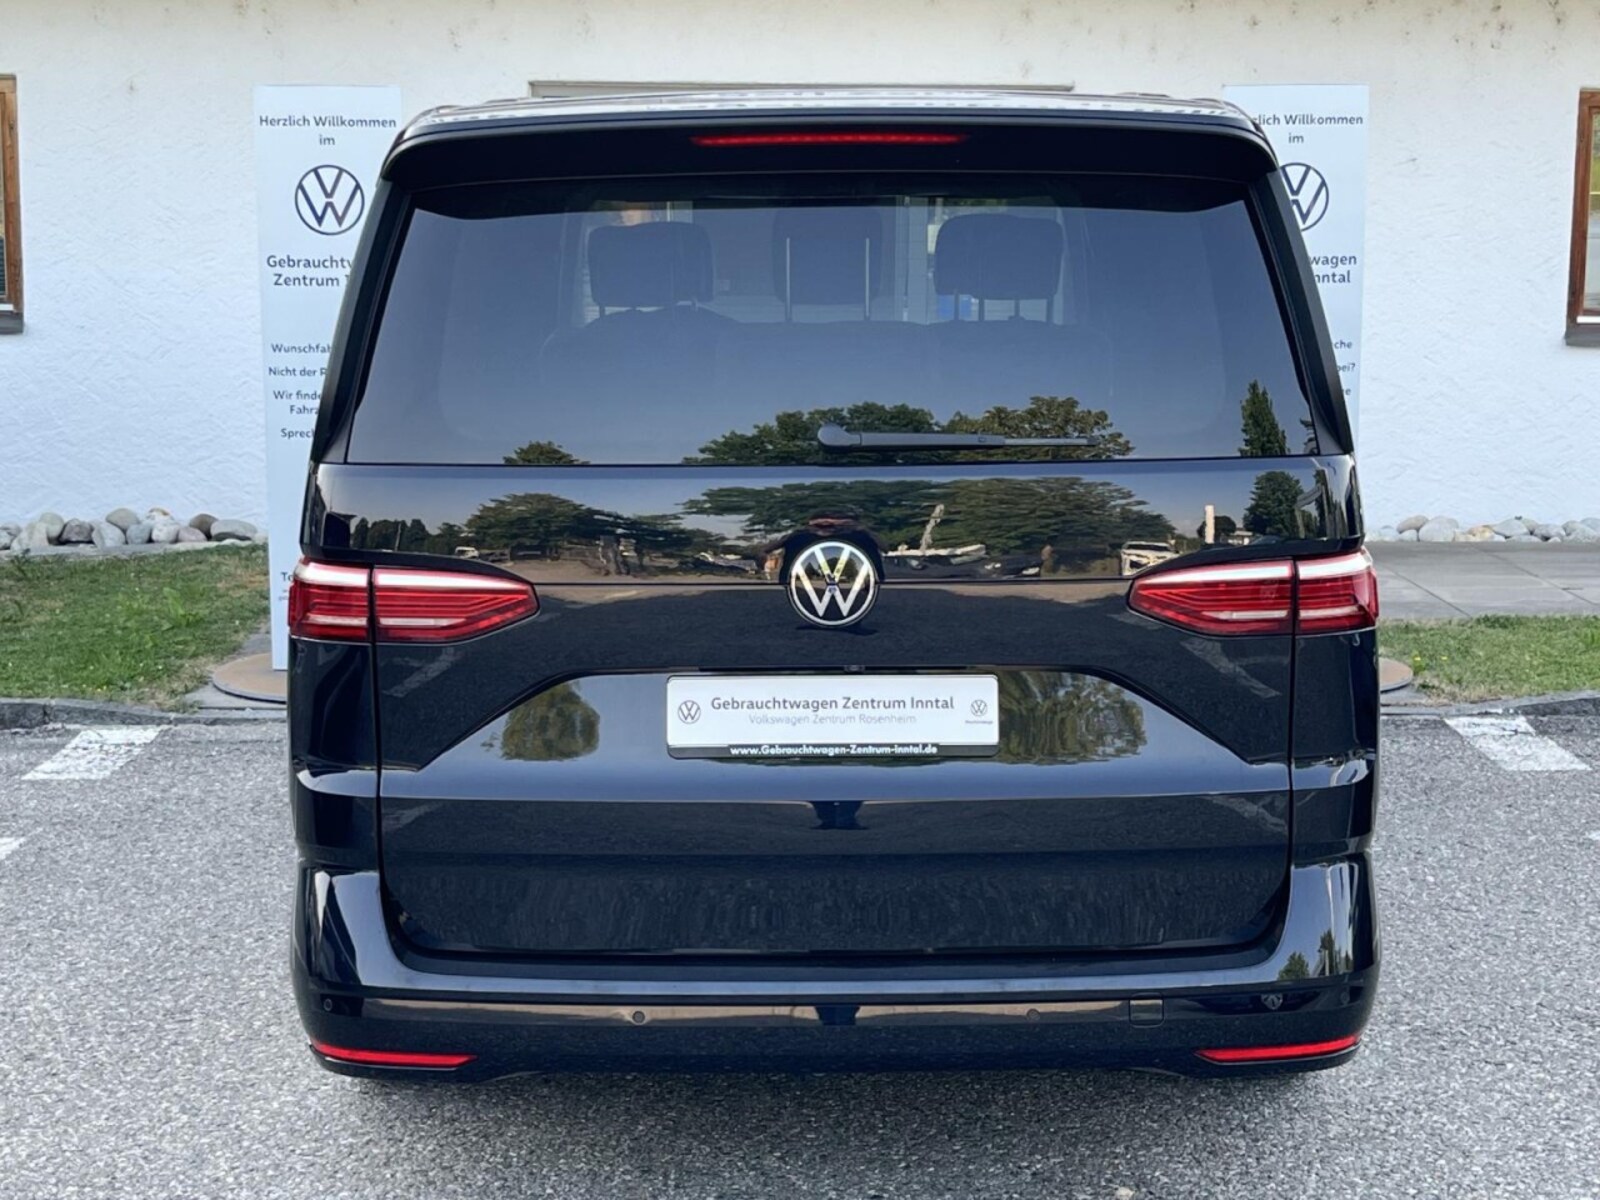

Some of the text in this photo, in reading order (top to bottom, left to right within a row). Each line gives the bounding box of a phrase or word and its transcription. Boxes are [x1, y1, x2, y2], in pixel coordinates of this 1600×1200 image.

[259, 115, 397, 128] Herzlich Willkommen
[1284, 114, 1364, 125] Willkommen
[319, 134, 336, 146] im
[1288, 133, 1304, 144] im
[273, 273, 340, 287] Zentrum
[268, 366, 297, 376] Nicht
[299, 367, 317, 377] der
[273, 390, 292, 400] Wir
[711, 697, 838, 712] Gebrauchtwagen
[842, 697, 906, 709] Zentrum
[910, 697, 955, 709] Inntal
[749, 713, 916, 726] Volkswagen Zentrum Rosenheim
